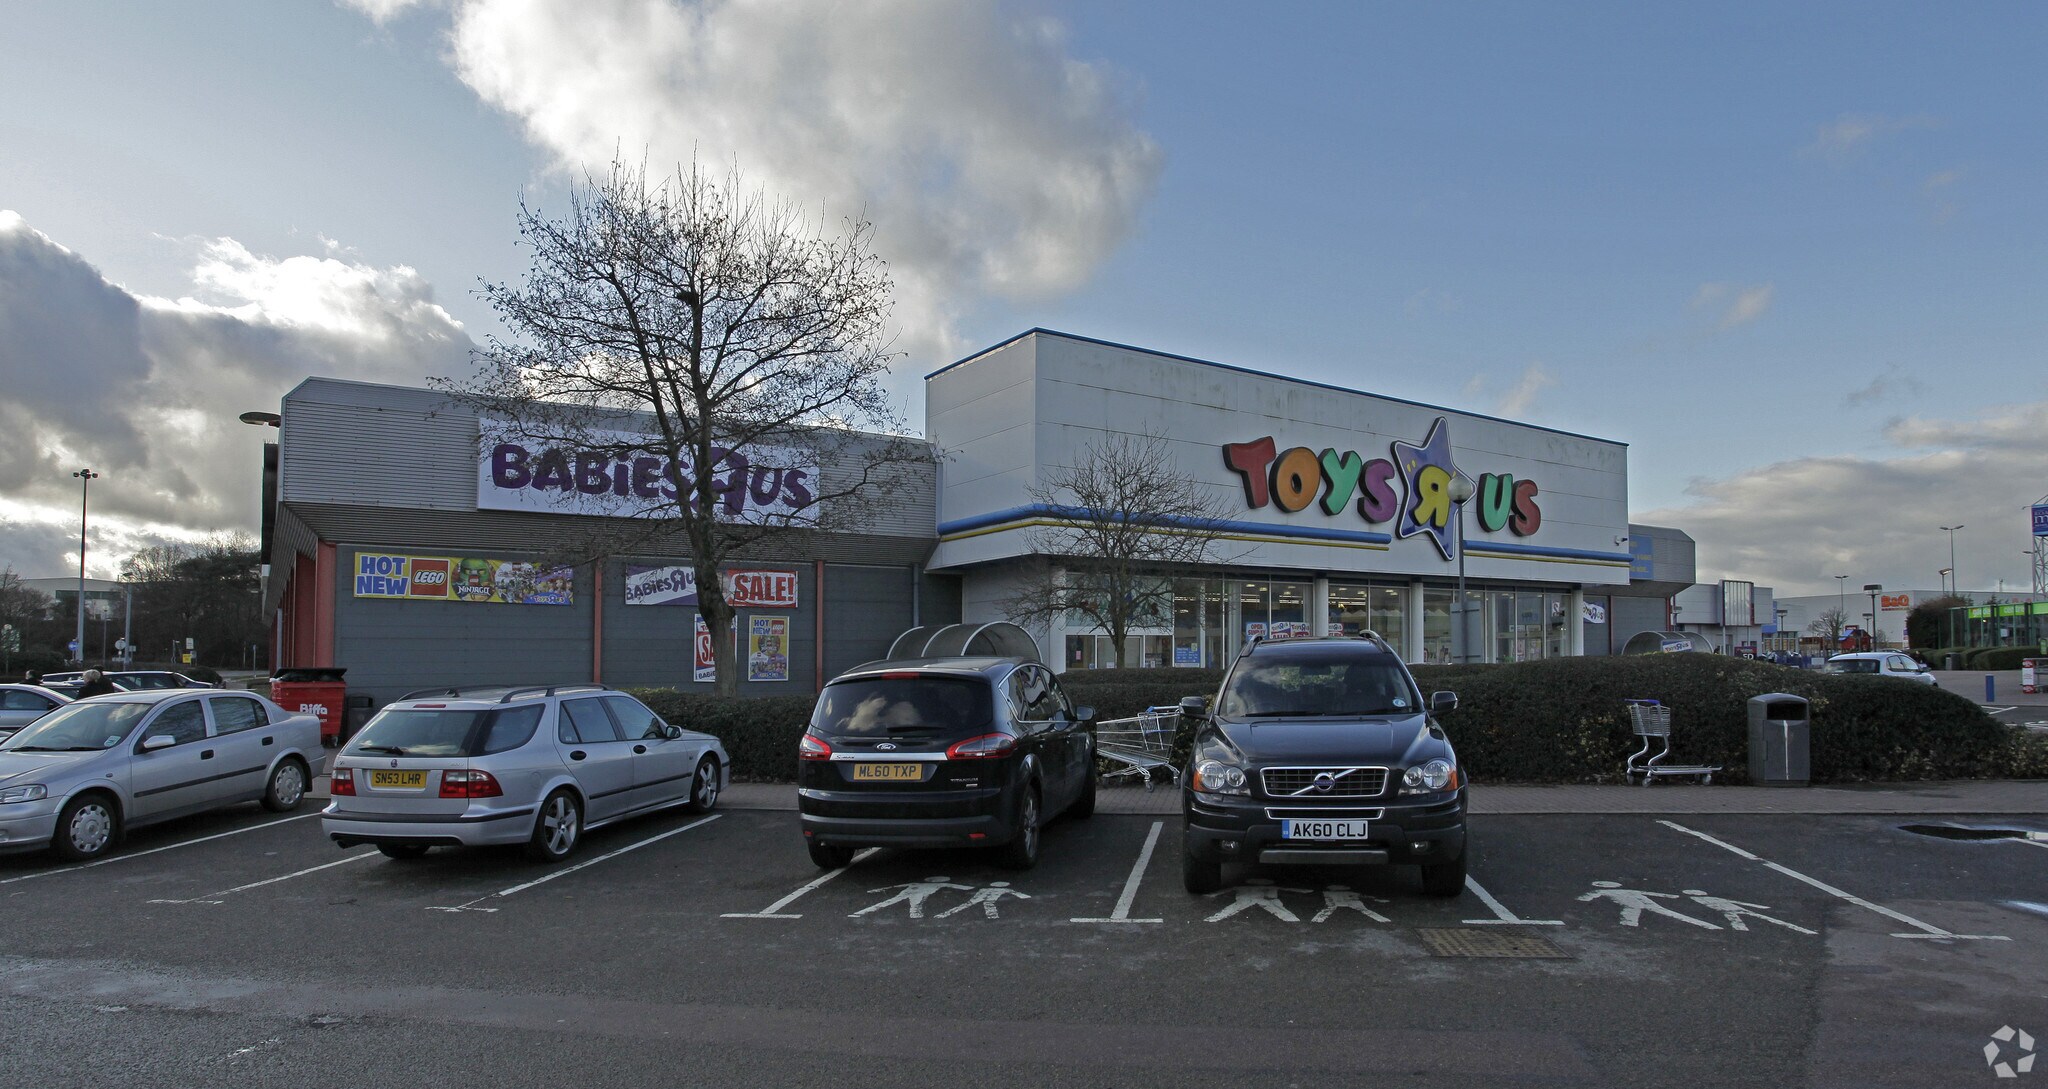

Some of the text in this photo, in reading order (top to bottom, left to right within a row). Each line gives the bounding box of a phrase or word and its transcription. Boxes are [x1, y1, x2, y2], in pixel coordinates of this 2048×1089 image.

[750, 467, 812, 508] US
[1222, 436, 1397, 524] TOYS
[1476, 472, 1541, 537] US
[361, 556, 406, 575] HOT
[414, 571, 446, 584] LEGO
[356, 576, 409, 595] NEW
[734, 574, 795, 602] SALE!
[1881, 595, 1909, 607] B&Q
[754, 619, 770, 627] HOT
[300, 703, 328, 715] Biffa
[859, 765, 917, 778] ML60 TXP
[375, 773, 421, 785] SN53 LHR
[1293, 823, 1366, 837] AK60 CLJ
